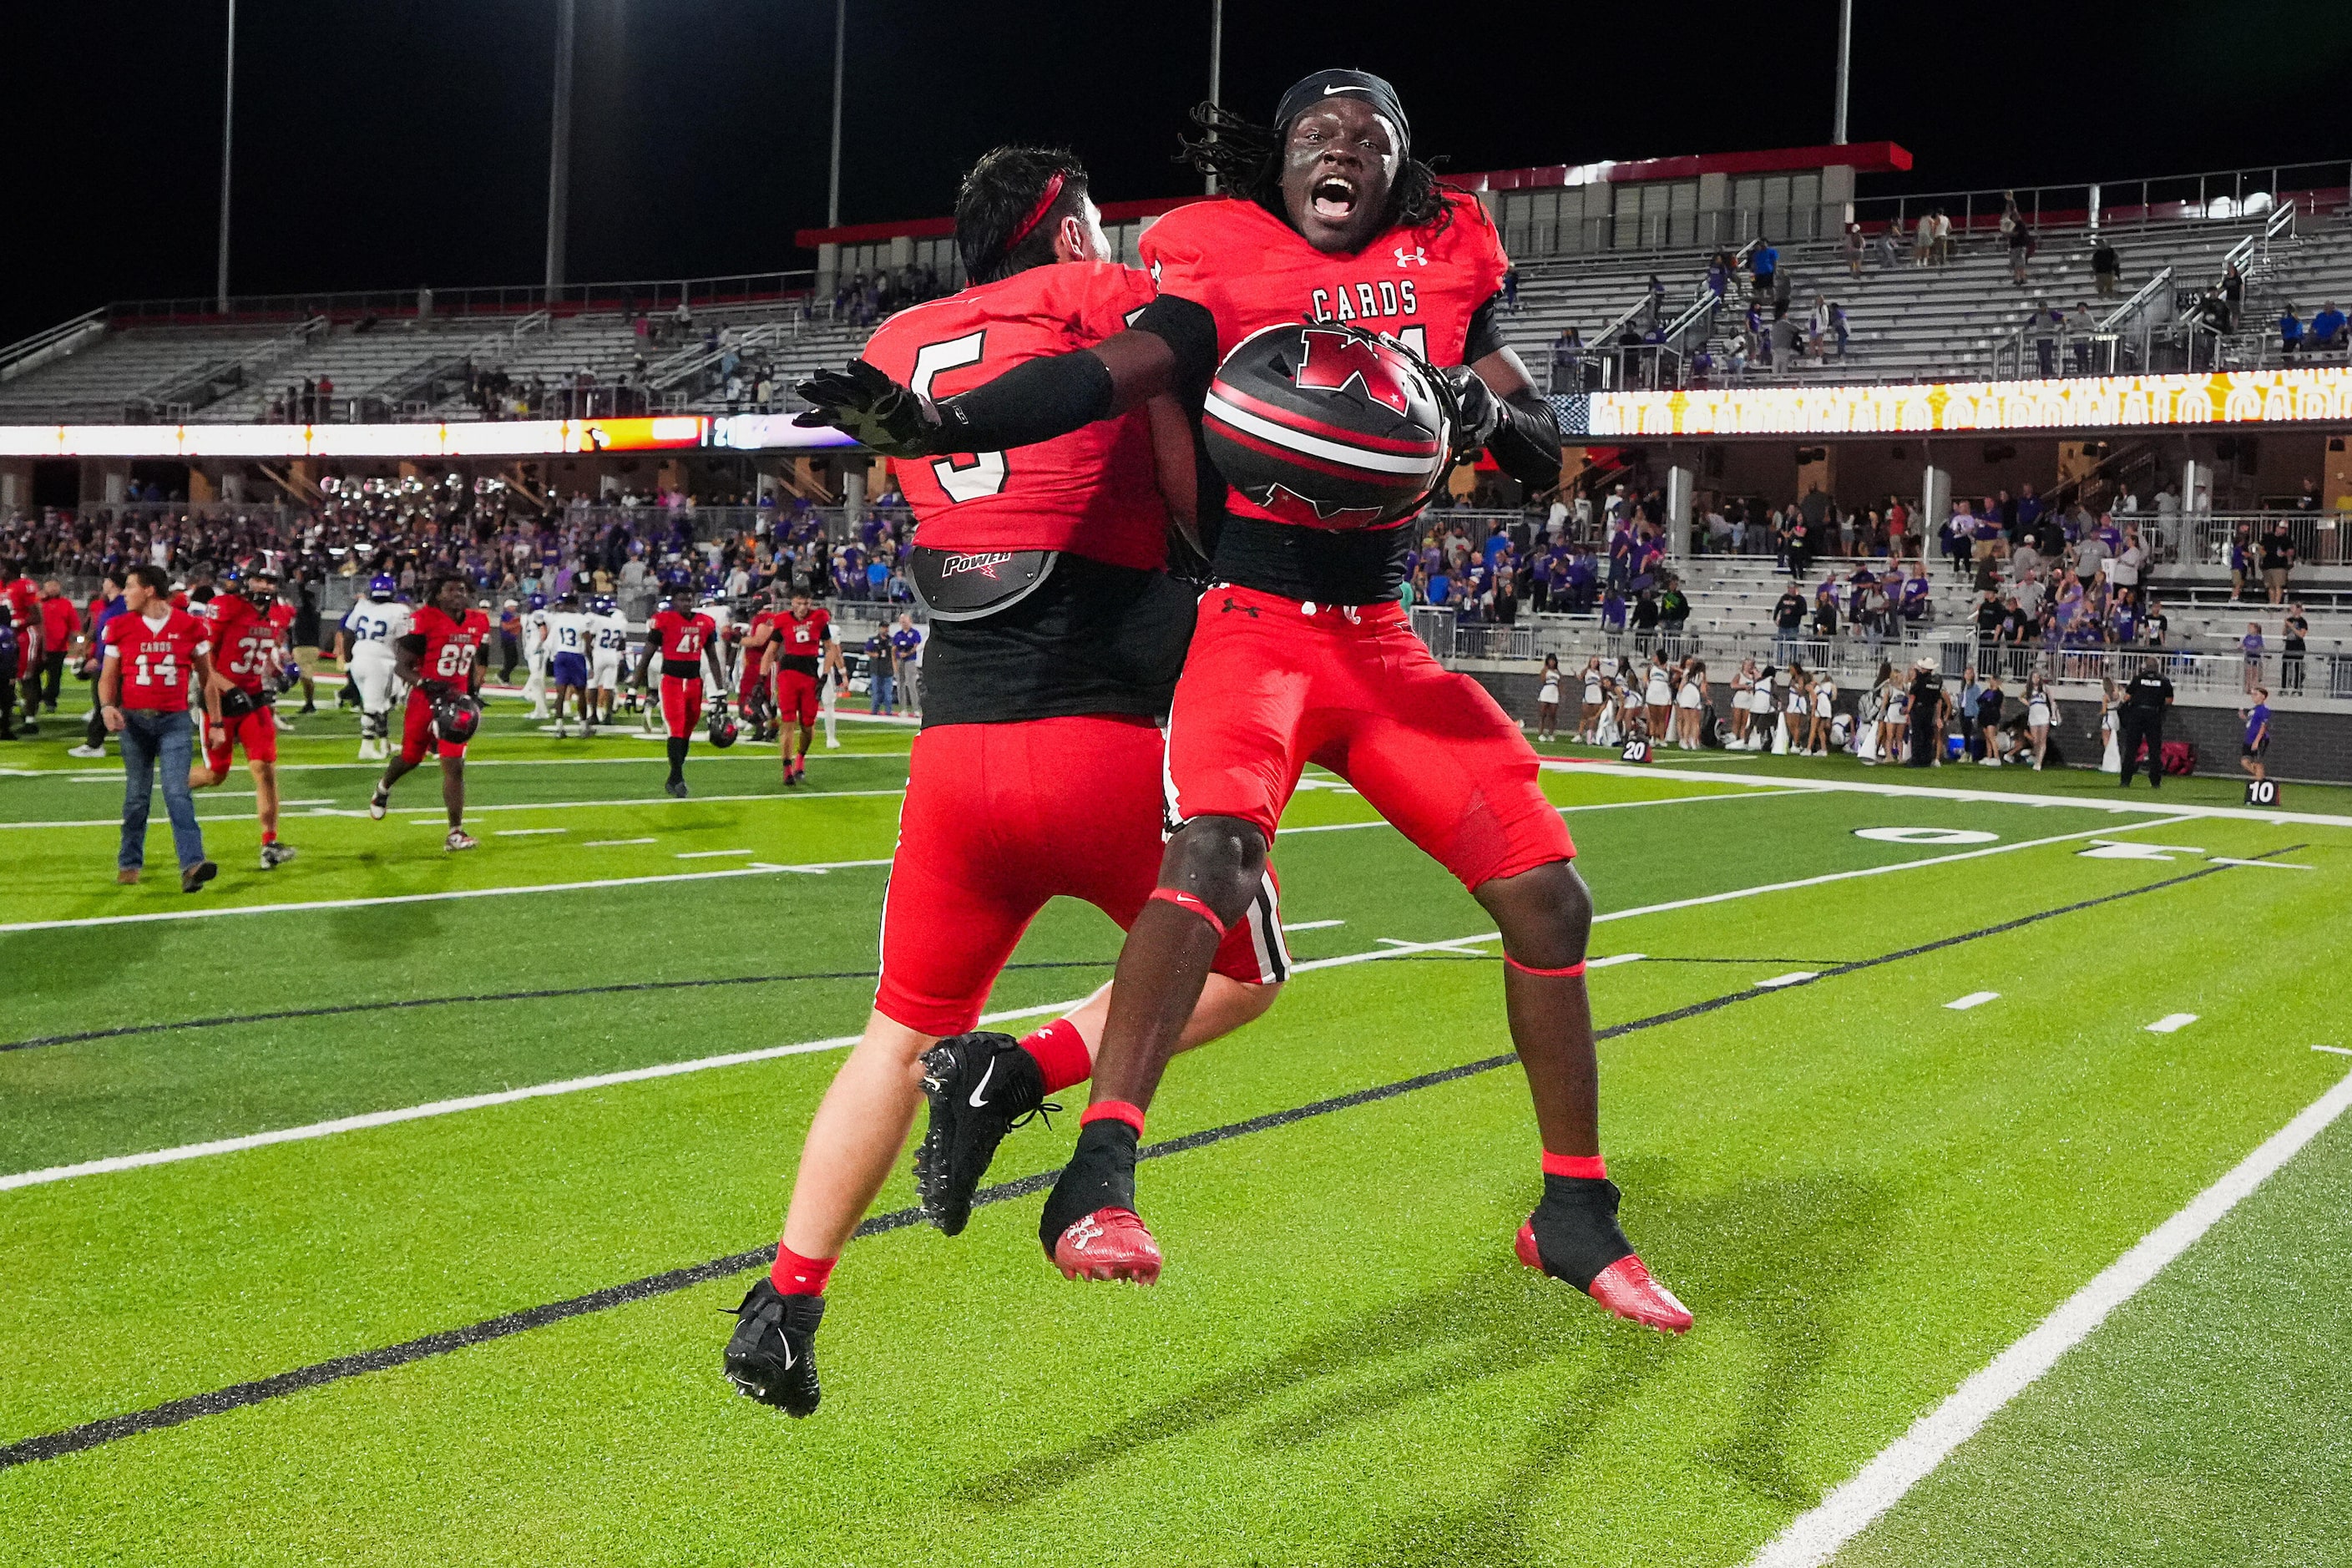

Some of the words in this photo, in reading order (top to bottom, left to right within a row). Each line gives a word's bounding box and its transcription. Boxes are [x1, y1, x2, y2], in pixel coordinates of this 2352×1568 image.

[1313, 281, 1418, 323] CARDS
[942, 552, 1013, 578] POWER
[355, 616, 388, 640] 62
[559, 627, 577, 647] 13
[230, 637, 276, 675] 35
[675, 634, 700, 654] 41
[134, 654, 178, 686] 14
[437, 644, 477, 677] 88
[1622, 741, 1646, 761] 20
[2248, 781, 2274, 803] 10
